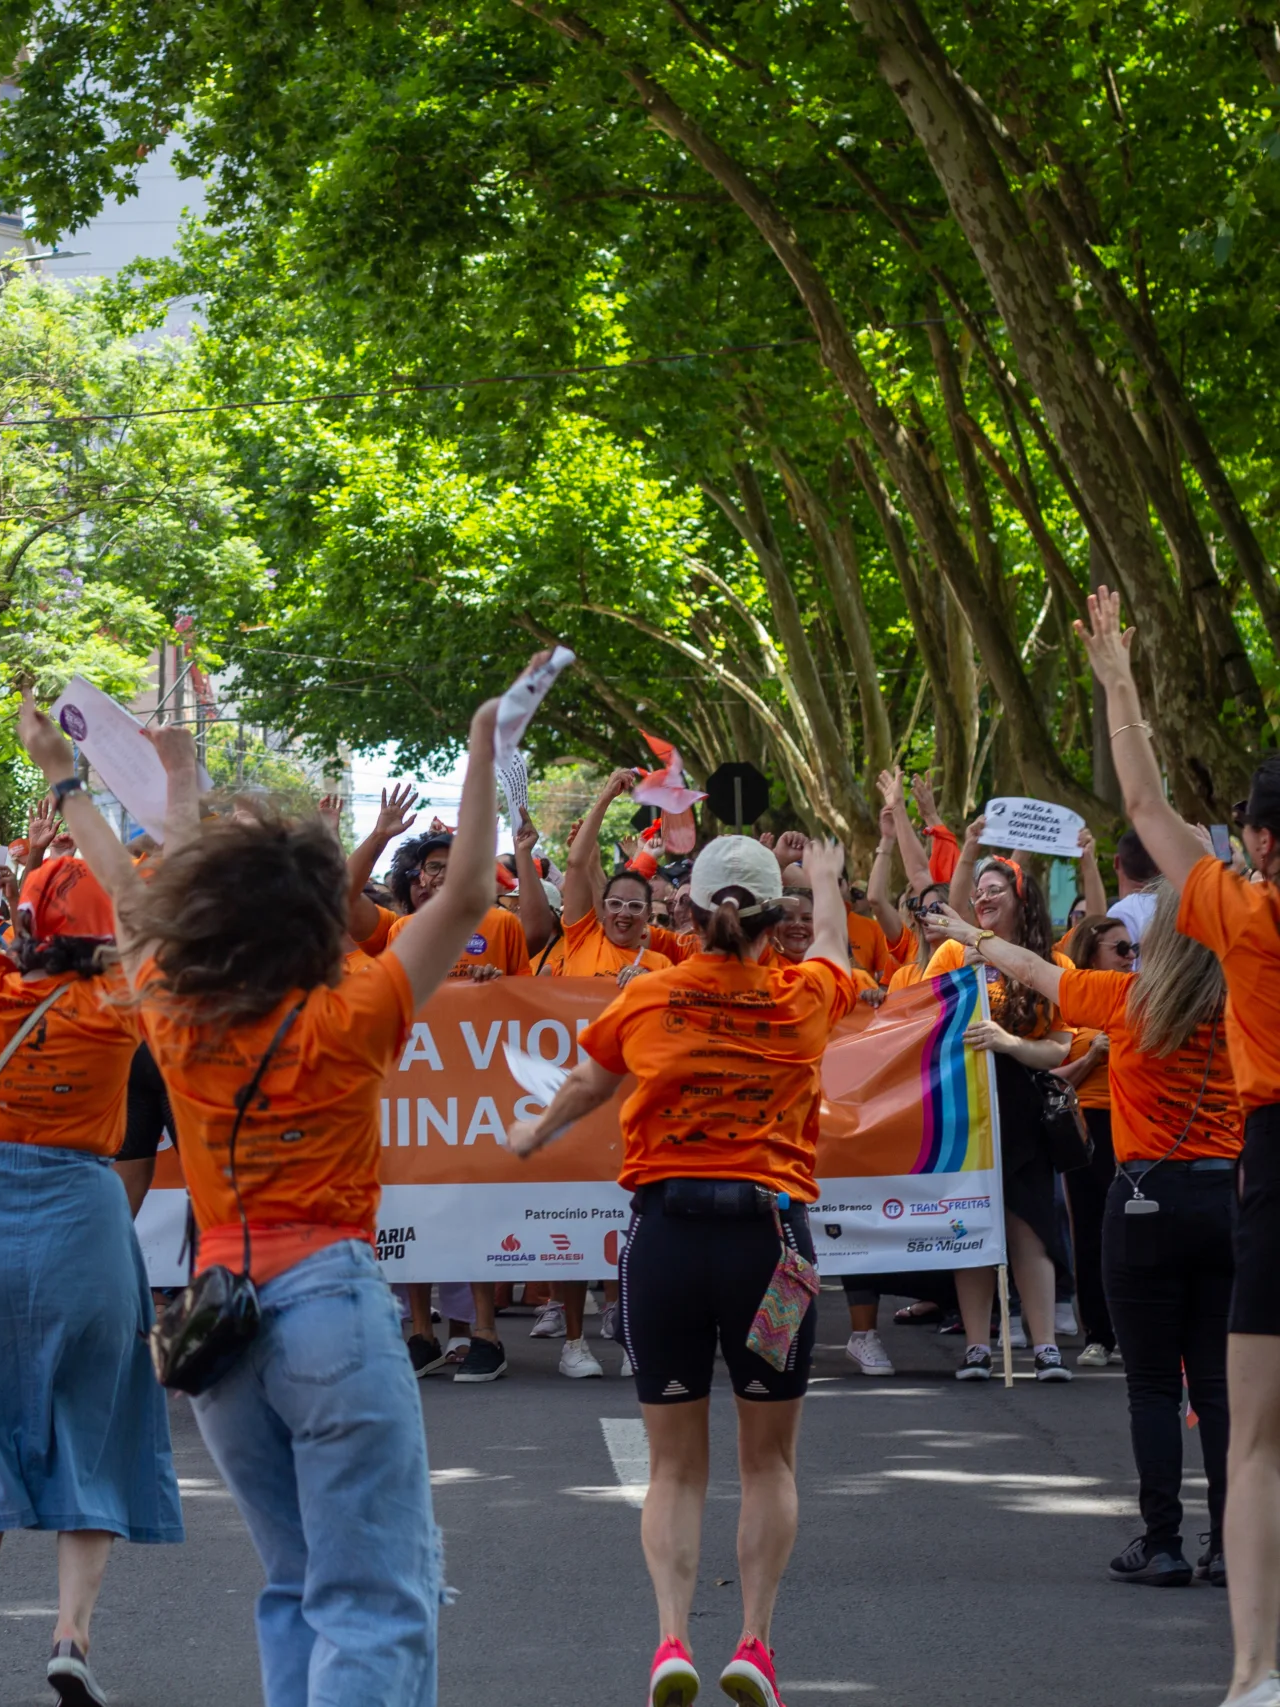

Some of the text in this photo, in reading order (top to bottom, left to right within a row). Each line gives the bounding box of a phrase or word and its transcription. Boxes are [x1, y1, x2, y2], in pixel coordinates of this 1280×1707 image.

[1008, 819, 1062, 834] CONTRA AS
[1008, 829, 1058, 843] MULHERES
[398, 1022, 445, 1072] A
[380, 1096, 550, 1147] INAS
[524, 1208, 625, 1220] Patrocínio Prata
[822, 1203, 837, 1212] Rio
[839, 1203, 872, 1212] Branco
[887, 1205, 900, 1214] TF
[376, 1226, 417, 1245] ARIA
[375, 1244, 406, 1261] RPO
[906, 1238, 984, 1254] São Miguel
[486, 1252, 536, 1262] PROGÁS
